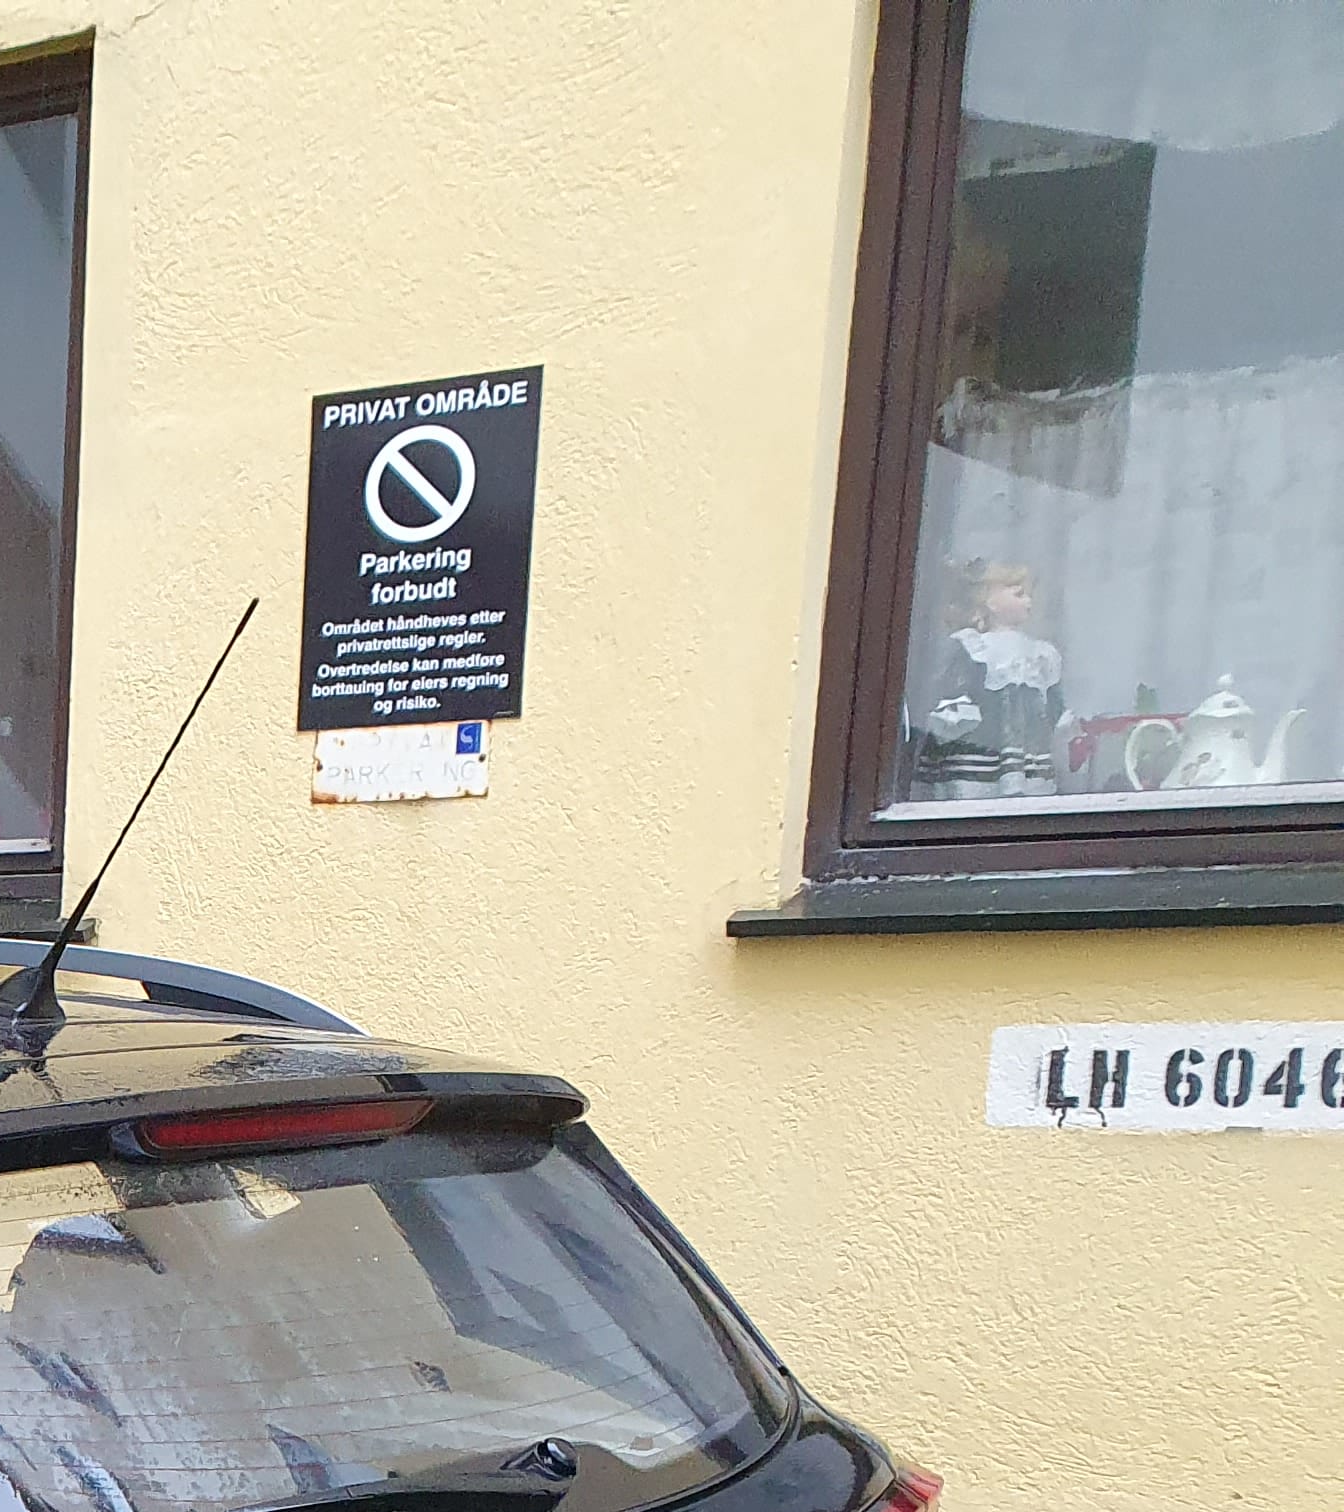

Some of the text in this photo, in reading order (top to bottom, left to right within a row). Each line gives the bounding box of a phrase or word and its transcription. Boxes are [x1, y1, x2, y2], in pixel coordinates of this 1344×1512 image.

[323, 380, 528, 429] PRIVAT OMRÅDE
[359, 546, 472, 577] Parkering
[370, 576, 457, 605] forbudt
[321, 610, 506, 637] Området håndheves etter
[336, 631, 487, 657] privatrettslige regler.
[317, 661, 409, 679] Overtredelse
[412, 658, 439, 672] kan
[311, 672, 509, 698] borttauing for eiers regning
[372, 695, 441, 714] og risiko.
[1045, 1046, 1130, 1116] LH
